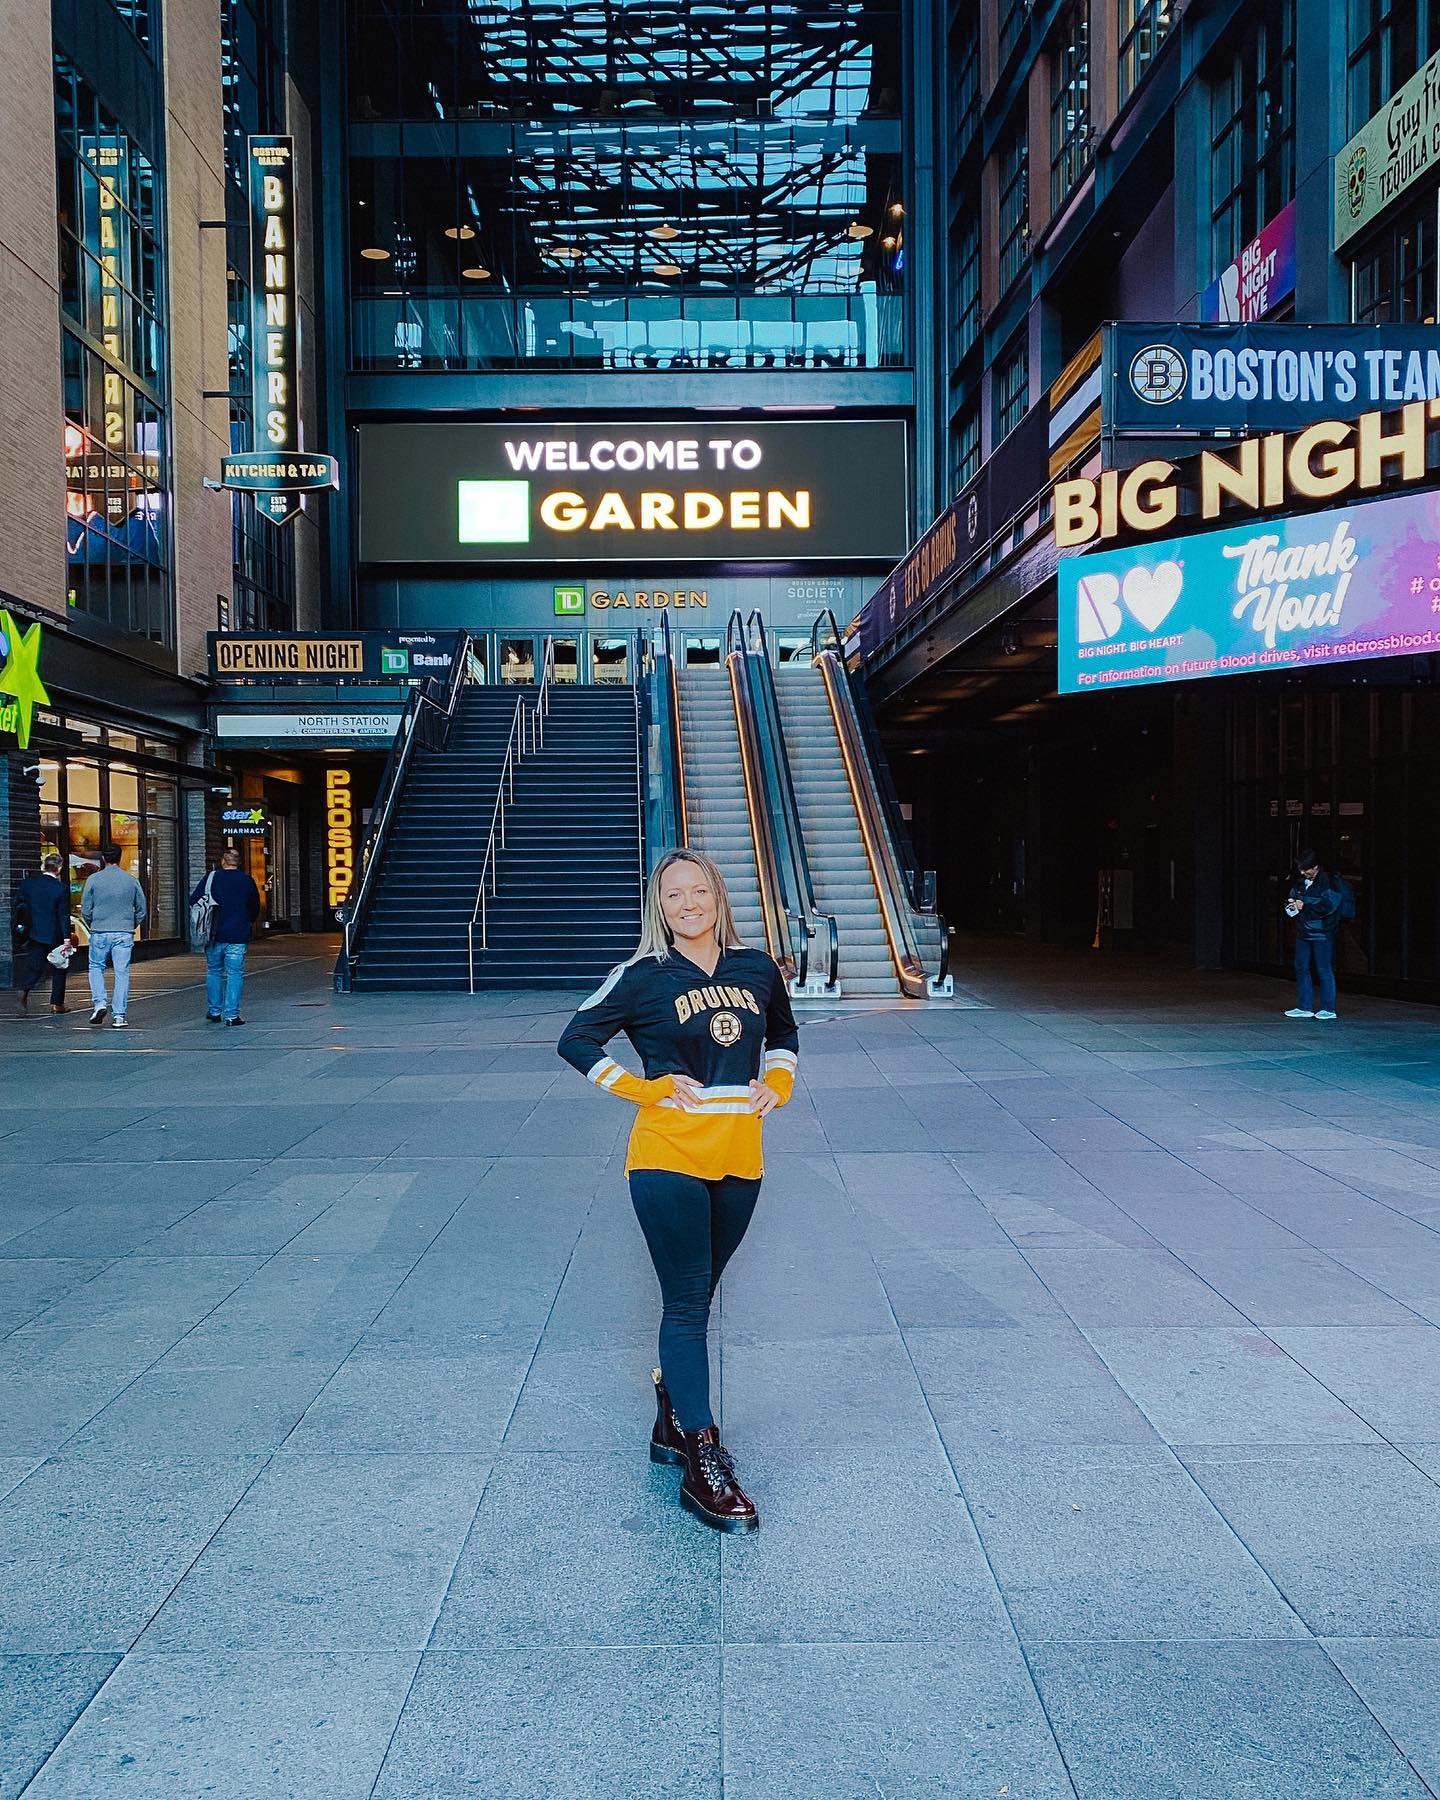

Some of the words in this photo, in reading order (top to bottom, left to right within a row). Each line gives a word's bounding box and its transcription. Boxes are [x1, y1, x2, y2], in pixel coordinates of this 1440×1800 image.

[1379, 134, 1429, 202] TEQUILA
[1242, 239, 1261, 278] BIG
[1242, 248, 1277, 304] NIGHT
[263, 176, 287, 444] BANNERS
[1191, 348, 1357, 402] BOSTON'S
[225, 464, 286, 478] KITCHEN
[287, 463, 299, 478] &
[299, 464, 327, 477] TAP
[504, 439, 699, 471] WELCOME
[708, 439, 762, 471] TO
[1054, 459, 1178, 548] BIG
[1202, 397, 1440, 519] NIGH
[540, 490, 811, 531] GARDEN
[1222, 520, 1359, 594] Thank
[557, 591, 582, 609] TD
[590, 591, 708, 609] GARDEN
[787, 587, 845, 599] SOCIETY
[1233, 571, 1353, 648] You!
[220, 643, 299, 669] OPENING
[305, 643, 360, 669] NIGHT
[428, 636, 436, 644] by
[1078, 648, 1095, 659] BIG
[1130, 640, 1147, 651] BIG
[384, 653, 406, 669] TD
[413, 653, 452, 666] Bank
[1078, 672, 1098, 685] For
[1099, 665, 1162, 683] information
[1164, 664, 1180, 674] on
[1182, 659, 1218, 673] future
[1220, 652, 1256, 668] blood
[1259, 649, 1301, 664] drives,
[1303, 643, 1331, 659] visit
[298, 716, 338, 726] NORTH
[342, 716, 389, 726] STATION
[222, 809, 251, 820] star
[674, 985, 760, 1024] BRUINS
